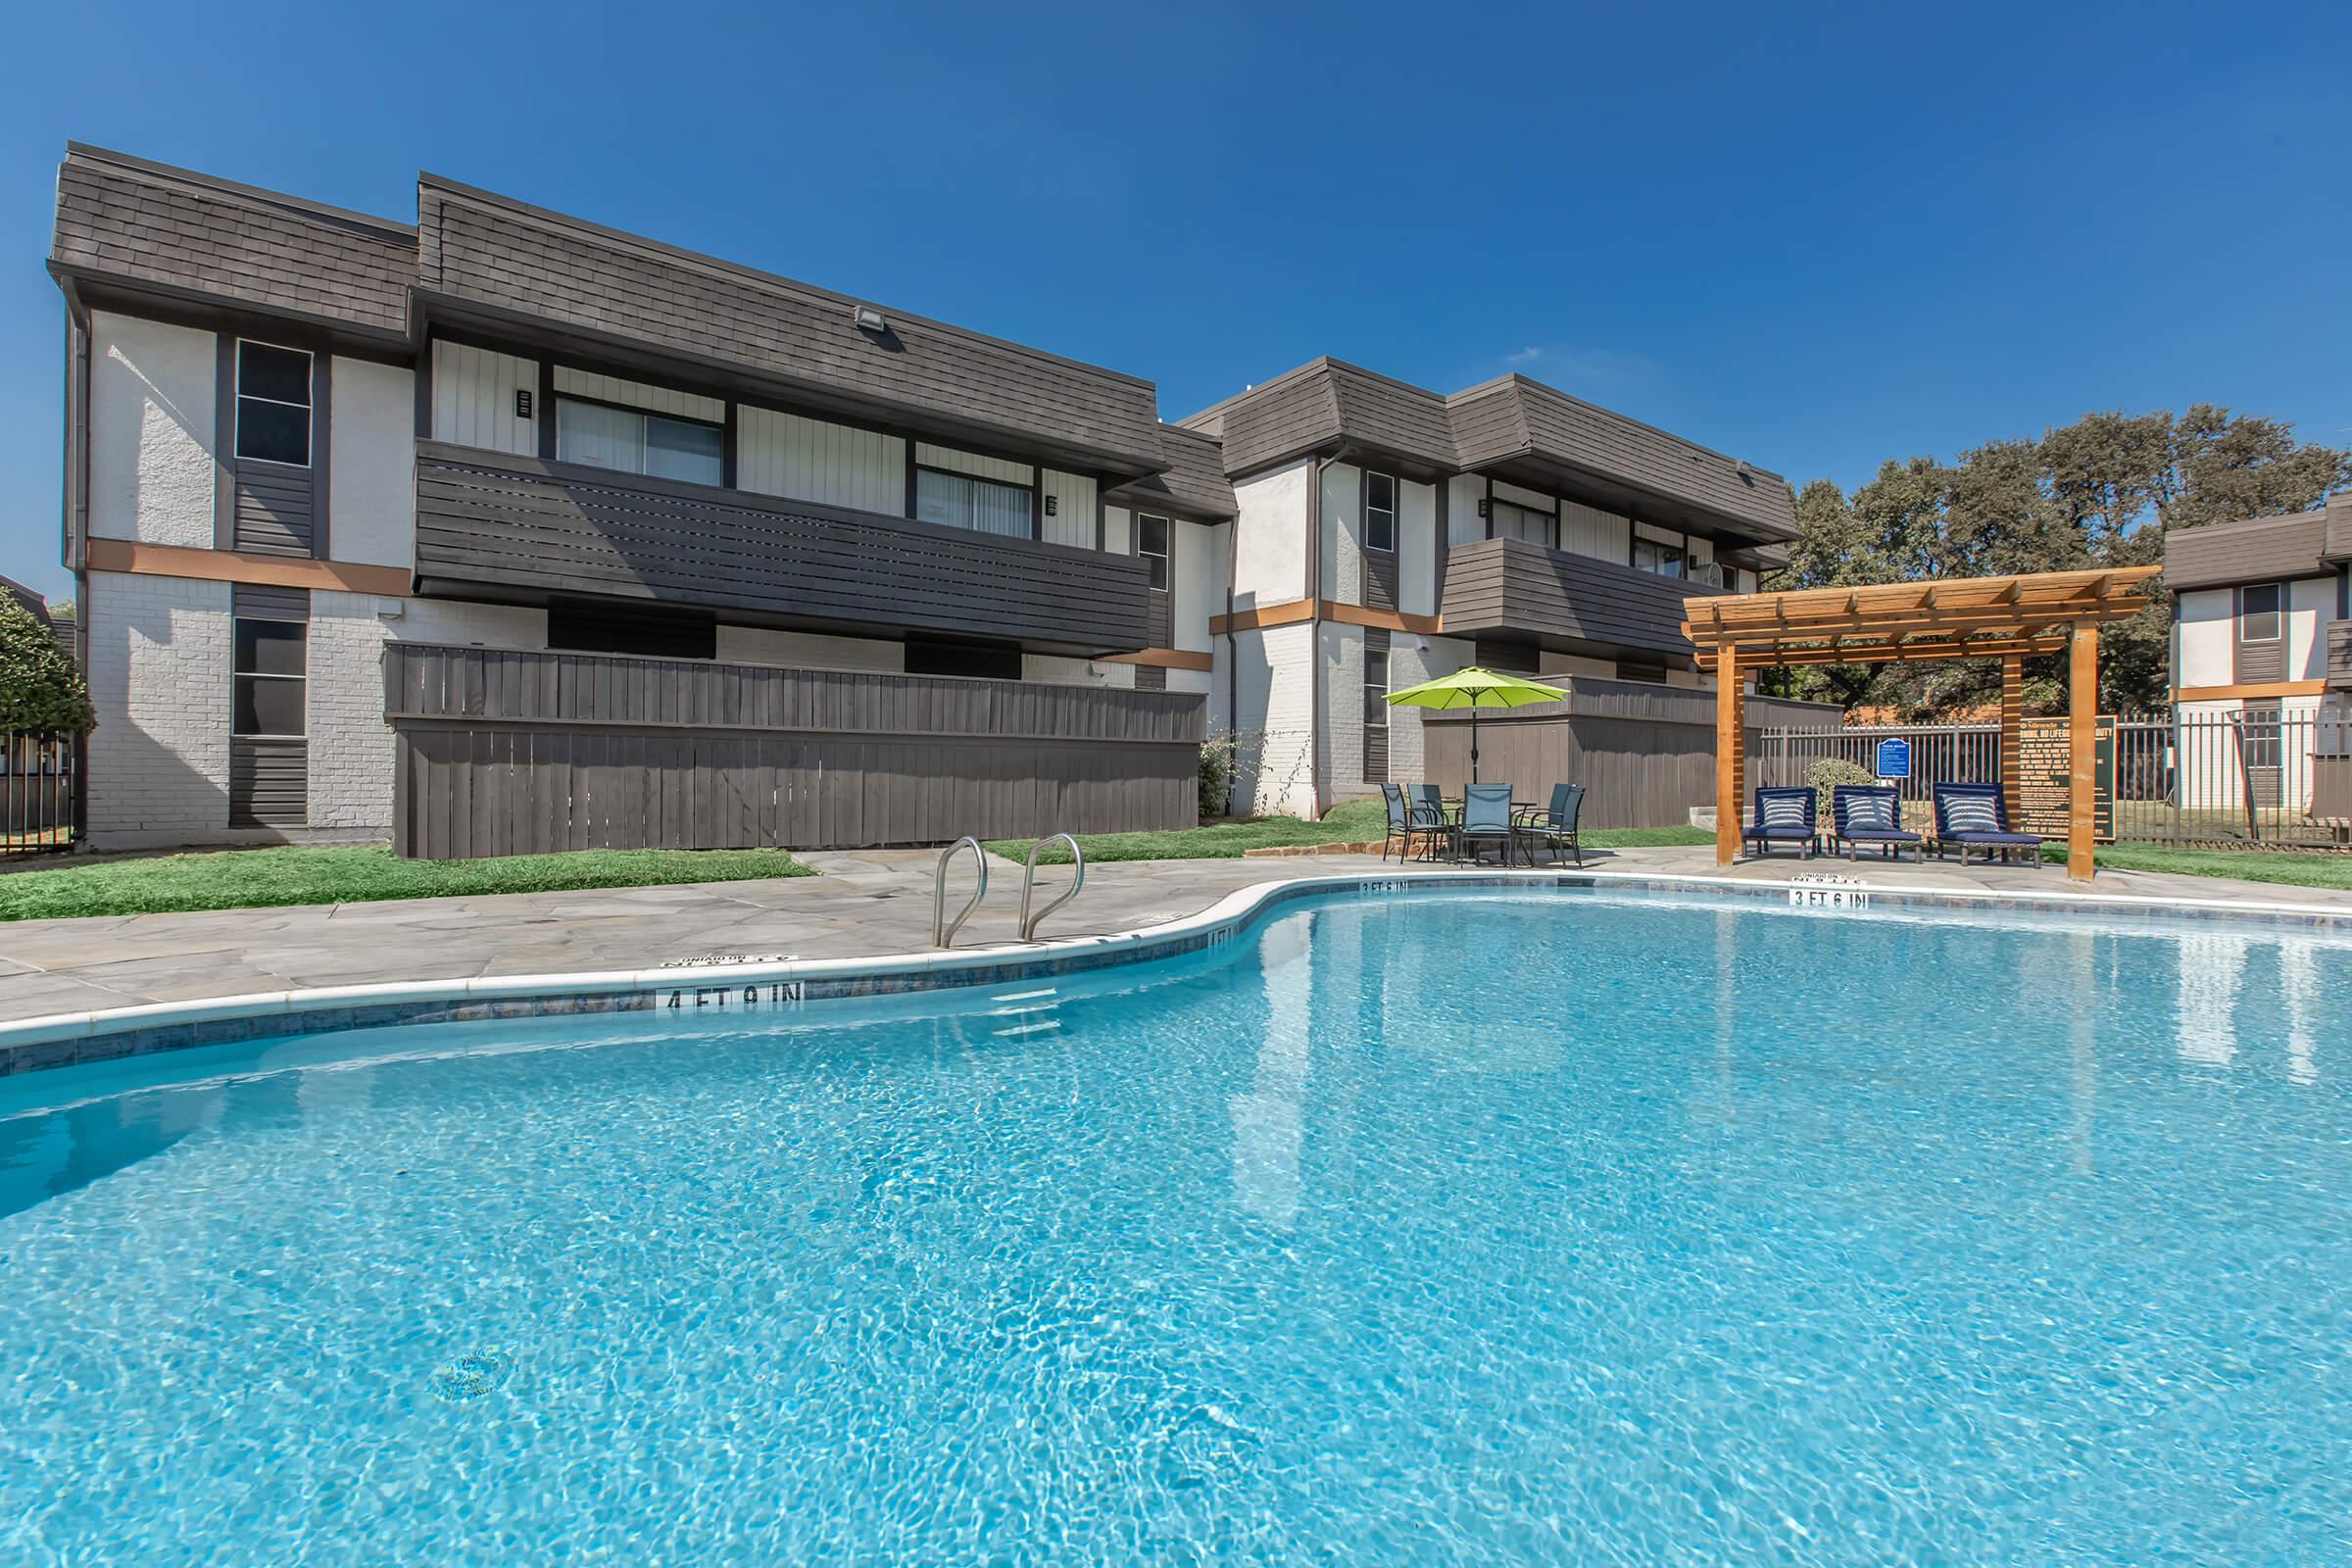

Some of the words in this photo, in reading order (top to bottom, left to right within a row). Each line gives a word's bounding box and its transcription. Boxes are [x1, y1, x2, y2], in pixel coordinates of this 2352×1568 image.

[1794, 890, 1803, 906] 3
[1809, 891, 1828, 906] FT
[1834, 893, 1842, 906] 6
[1849, 893, 1866, 908] IN
[696, 987, 731, 1007] FT
[772, 982, 801, 1003] IN
